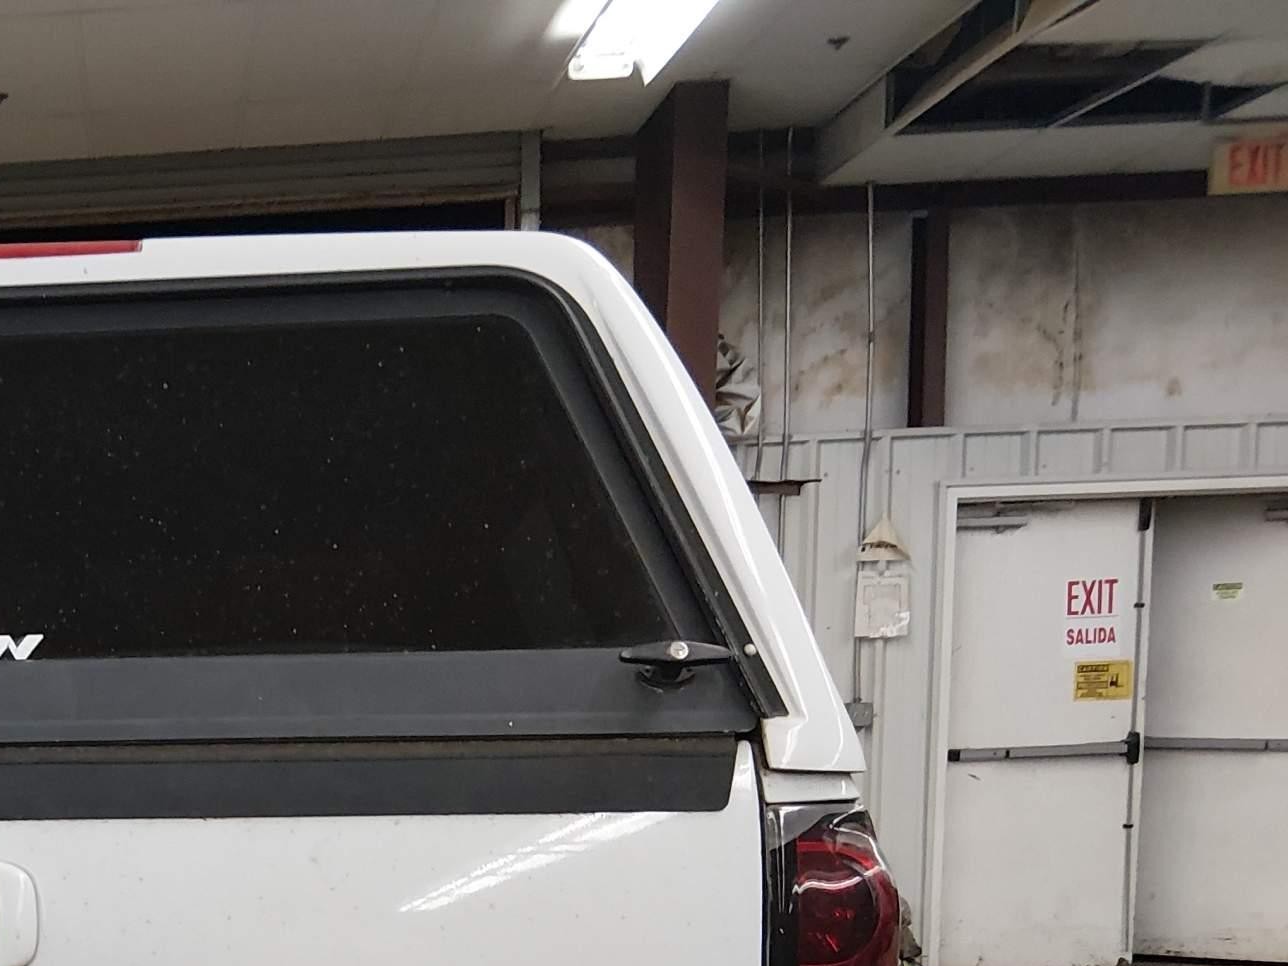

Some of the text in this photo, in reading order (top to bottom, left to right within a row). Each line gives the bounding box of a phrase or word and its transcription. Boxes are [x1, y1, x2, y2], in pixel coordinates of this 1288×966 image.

[1229, 143, 1287, 187] EXIT
[1066, 579, 1119, 615] EXIT
[1066, 627, 1116, 645] SALIDA
